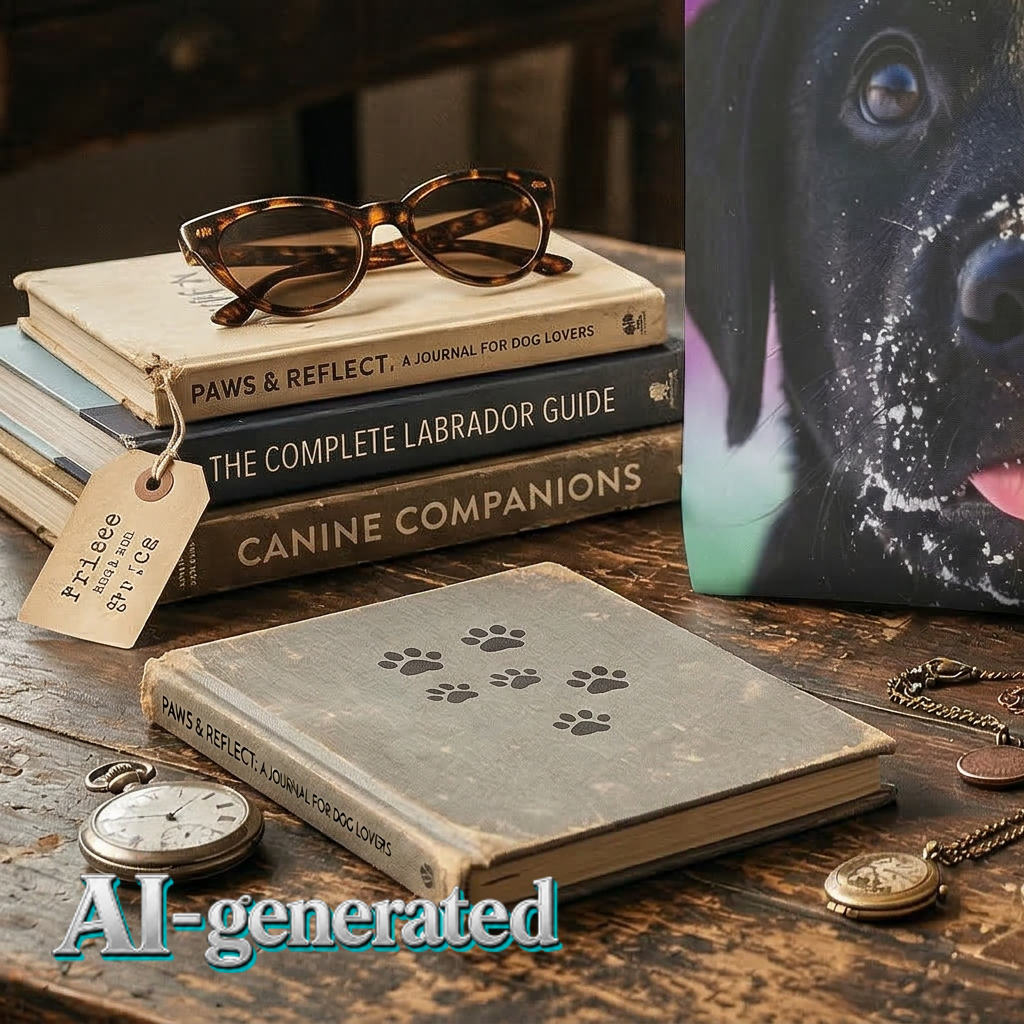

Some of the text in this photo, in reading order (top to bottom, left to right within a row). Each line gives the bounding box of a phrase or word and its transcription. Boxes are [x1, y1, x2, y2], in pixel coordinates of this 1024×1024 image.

[191, 375, 256, 404] PAWS
[263, 371, 280, 393] &
[402, 355, 412, 367] A
[414, 343, 477, 366] JOURNAL
[481, 339, 508, 355] FOR
[511, 333, 541, 349] DOG
[545, 325, 595, 344] LOVERS
[209, 386, 616, 482] THE COMPLETE LABRADOR GUIDE
[237, 511, 383, 567] CANINE
[395, 462, 642, 535] COMPANIONS
[162, 695, 193, 730] PAWS
[195, 717, 204, 738] &
[206, 724, 258, 772] REFLECT:
[260, 762, 268, 777] A
[268, 765, 310, 805] JOURNAL
[312, 794, 331, 818] FOR
